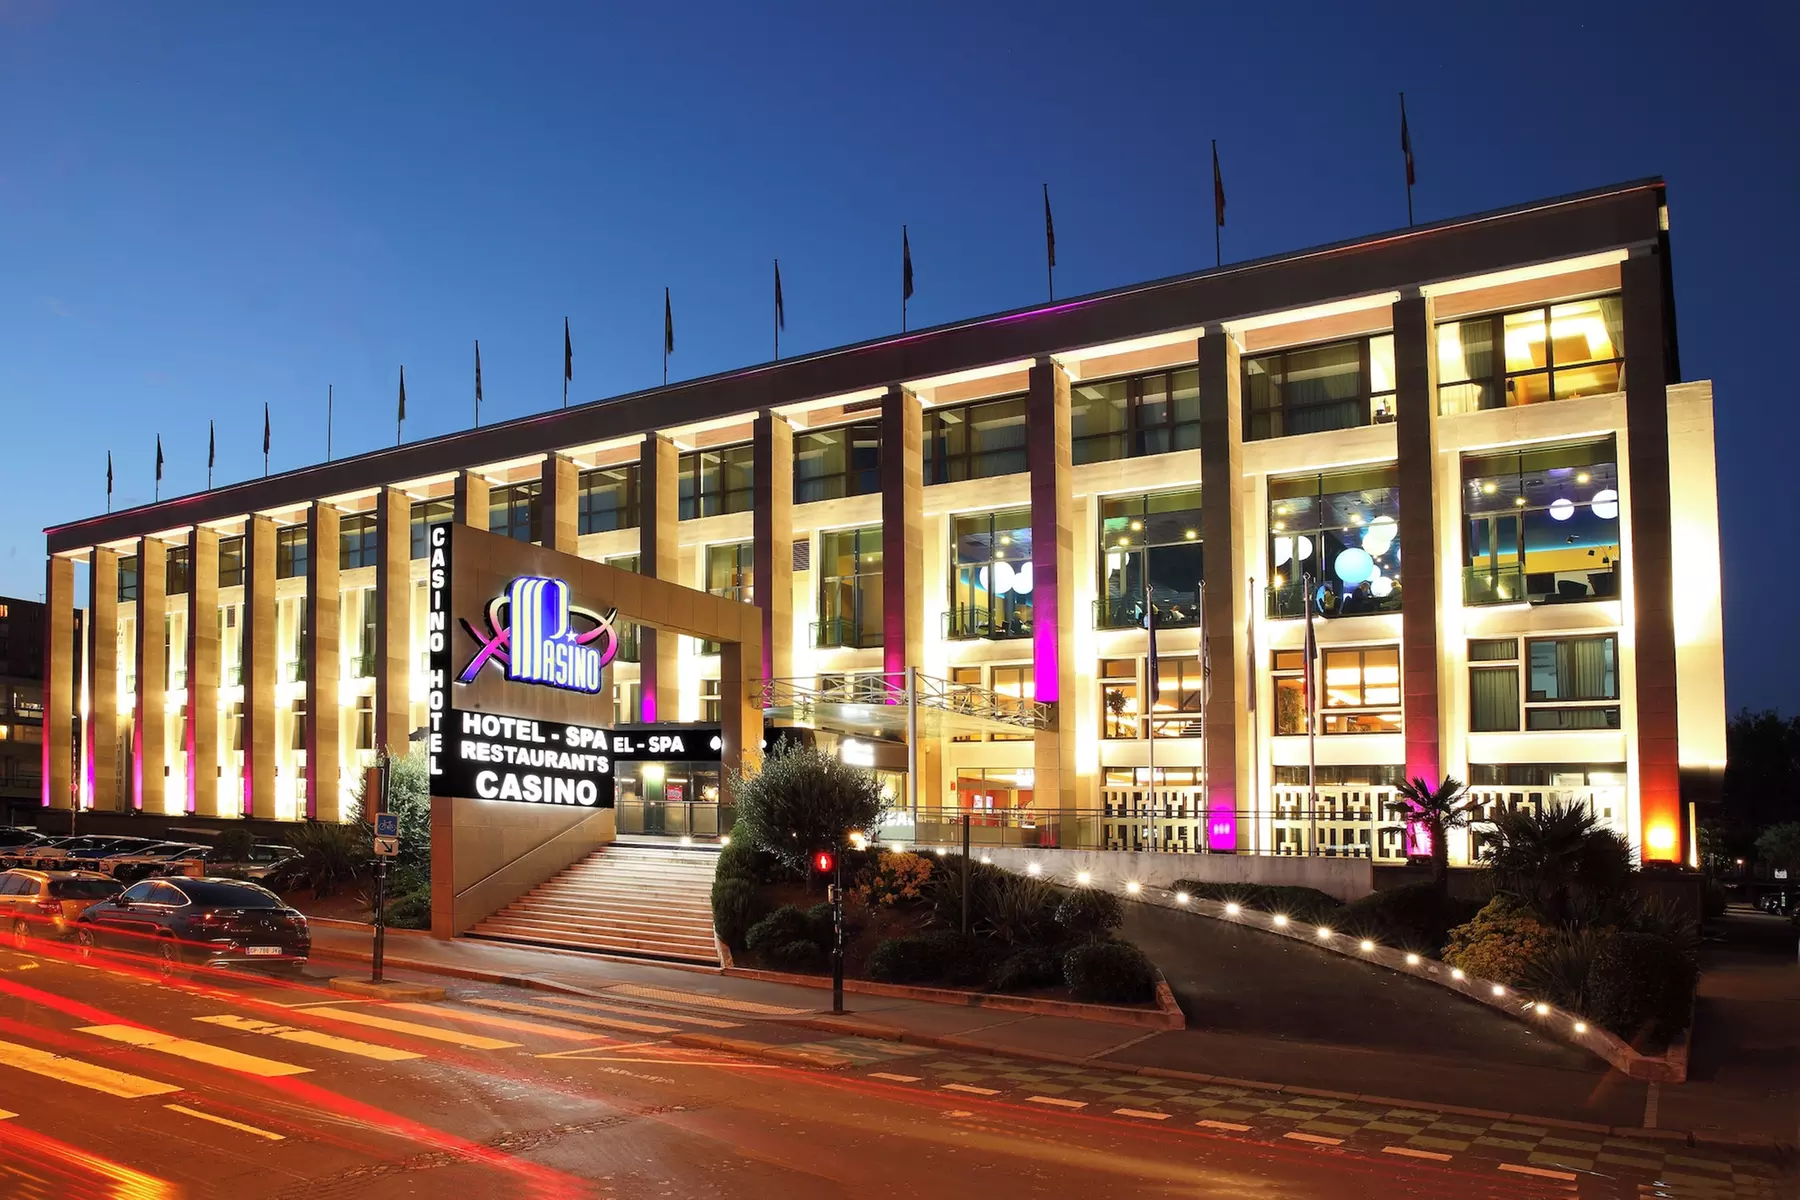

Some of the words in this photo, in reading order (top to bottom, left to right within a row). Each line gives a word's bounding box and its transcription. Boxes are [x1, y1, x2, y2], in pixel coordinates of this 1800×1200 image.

[430, 527, 446, 653] CASINO
[429, 669, 444, 775] HOTEL
[462, 711, 546, 743] HOTEL
[565, 725, 608, 750] SPA
[461, 740, 610, 774] RESTAURANTS
[648, 735, 685, 753] SPA
[475, 770, 598, 806] CASINO
